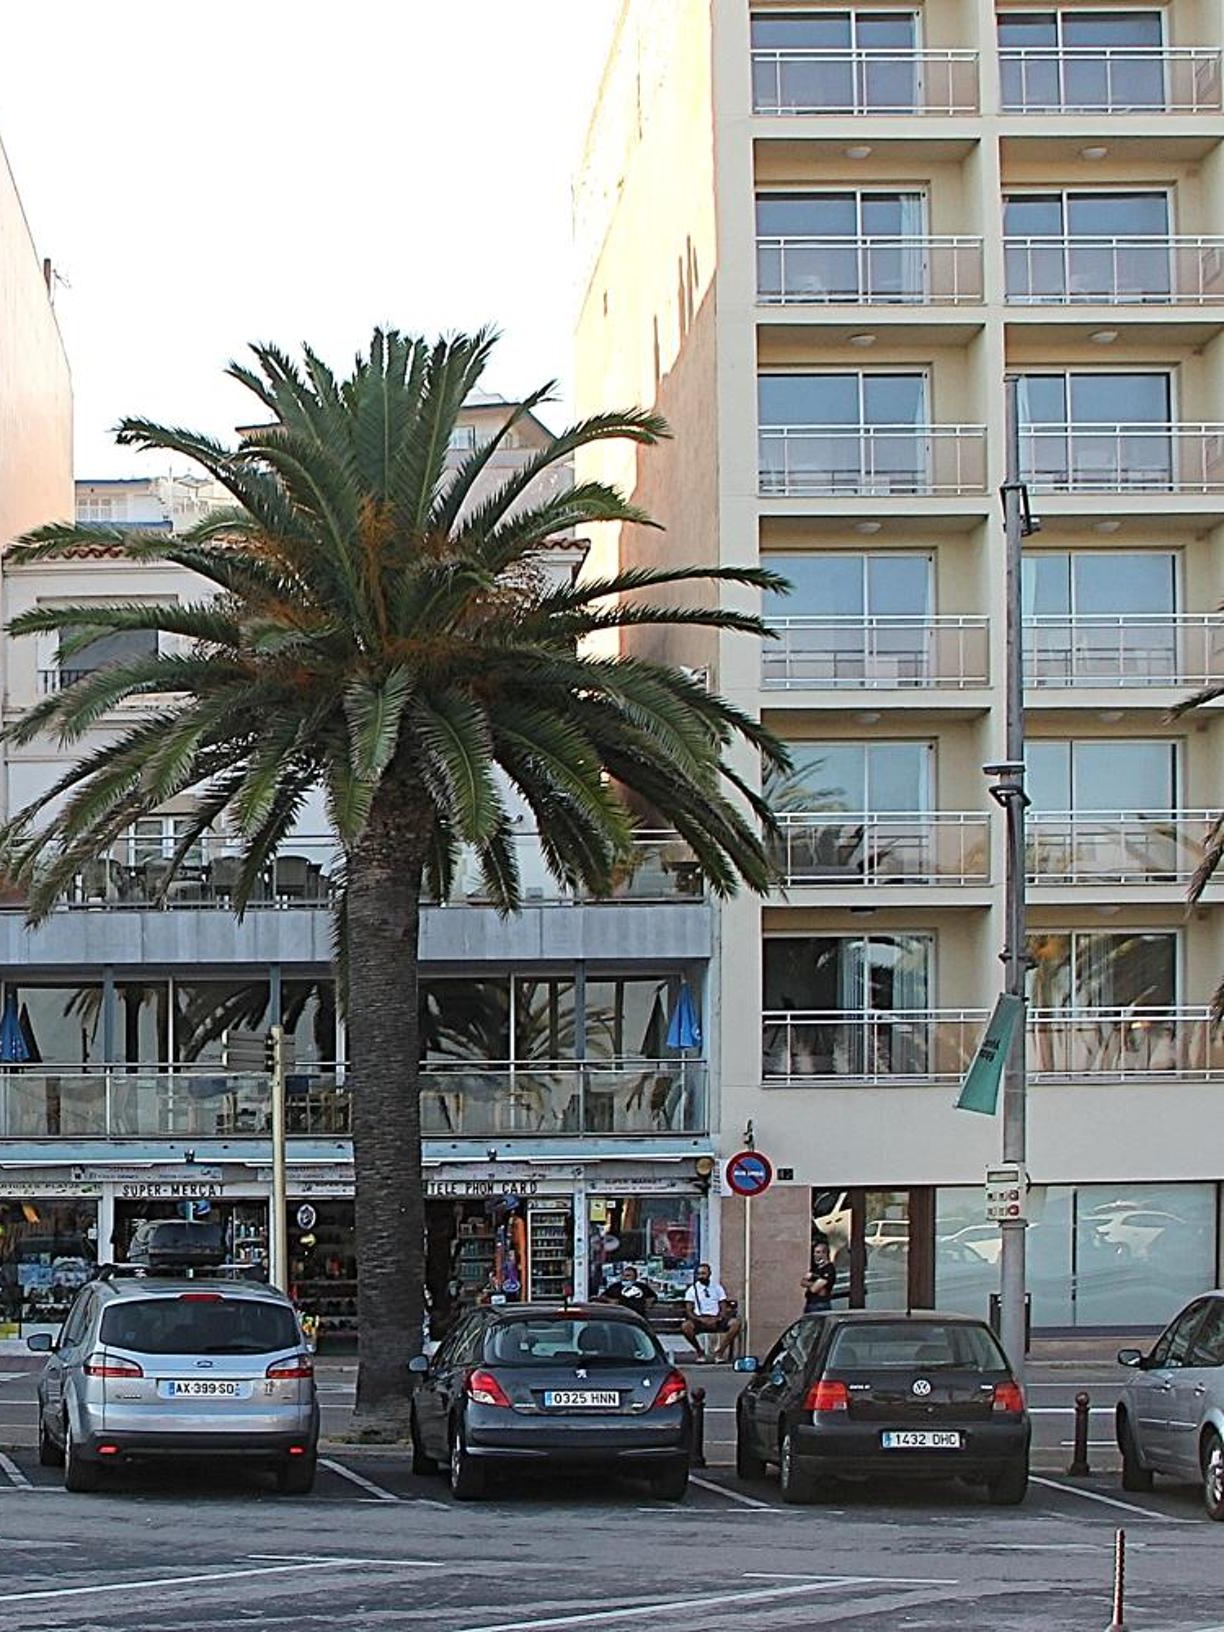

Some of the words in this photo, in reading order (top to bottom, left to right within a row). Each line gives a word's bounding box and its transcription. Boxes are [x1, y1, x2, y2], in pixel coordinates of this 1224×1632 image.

[429, 1181, 457, 1196] TELE
[501, 1181, 537, 1195] CARD
[554, 1392, 588, 1404] 0325
[591, 1392, 617, 1404] HNN
[895, 1433, 926, 1445] 1432
